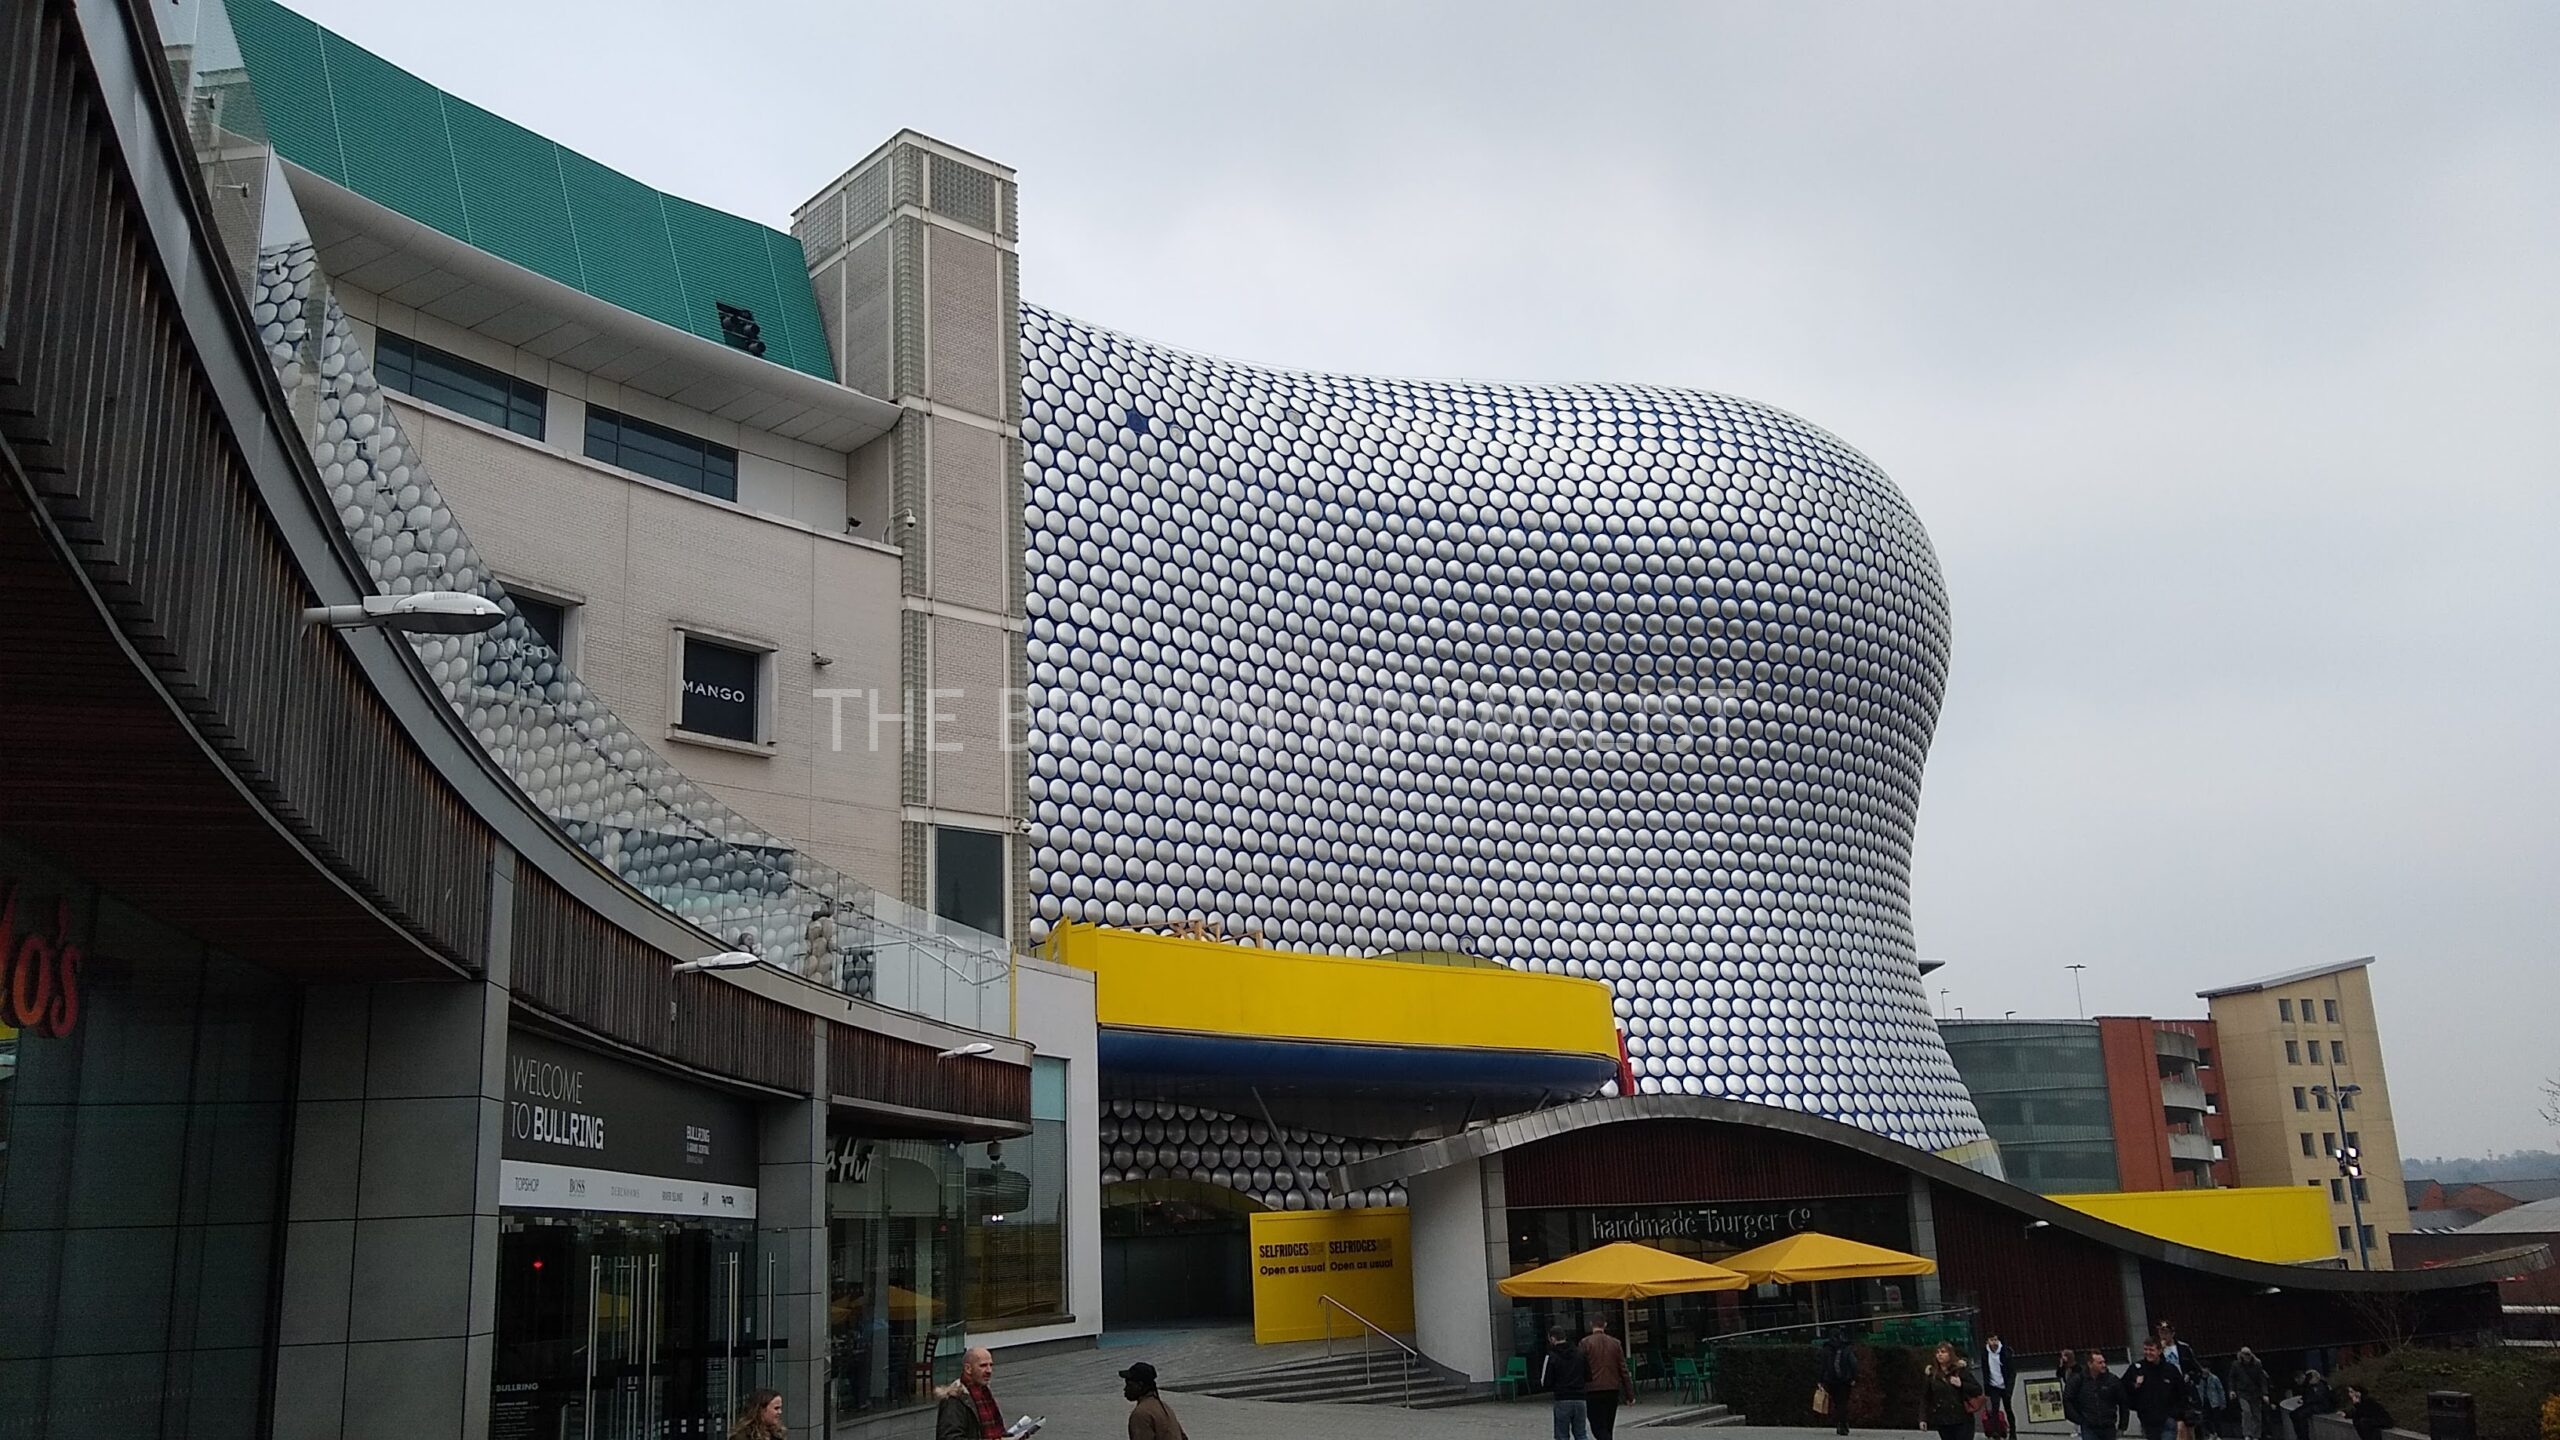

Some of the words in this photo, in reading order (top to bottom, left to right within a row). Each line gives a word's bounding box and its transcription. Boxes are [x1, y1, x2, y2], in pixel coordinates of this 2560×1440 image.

[681, 680, 745, 702] MANGO
[513, 1055, 583, 1104] WELCOME
[511, 1101, 530, 1139] TO
[534, 1105, 604, 1150] BULLRING
[839, 1137, 880, 1182] Hut
[515, 1177, 539, 1192] TOPSHOP
[569, 1178, 585, 1193] BOSS
[1592, 1209, 1698, 1239] handmade
[1699, 1208, 1778, 1239] burger
[1259, 1243, 1309, 1258] SELFRIDGES
[1329, 1240, 1376, 1254] SELFRIDGES
[1260, 1265, 1286, 1276] Open
[1288, 1265, 1299, 1273] as
[1301, 1263, 1325, 1273] usual
[1330, 1261, 1356, 1272] Open
[1357, 1260, 1368, 1269] as
[1370, 1258, 1393, 1268] usual
[496, 1383, 539, 1392] BULLRING
